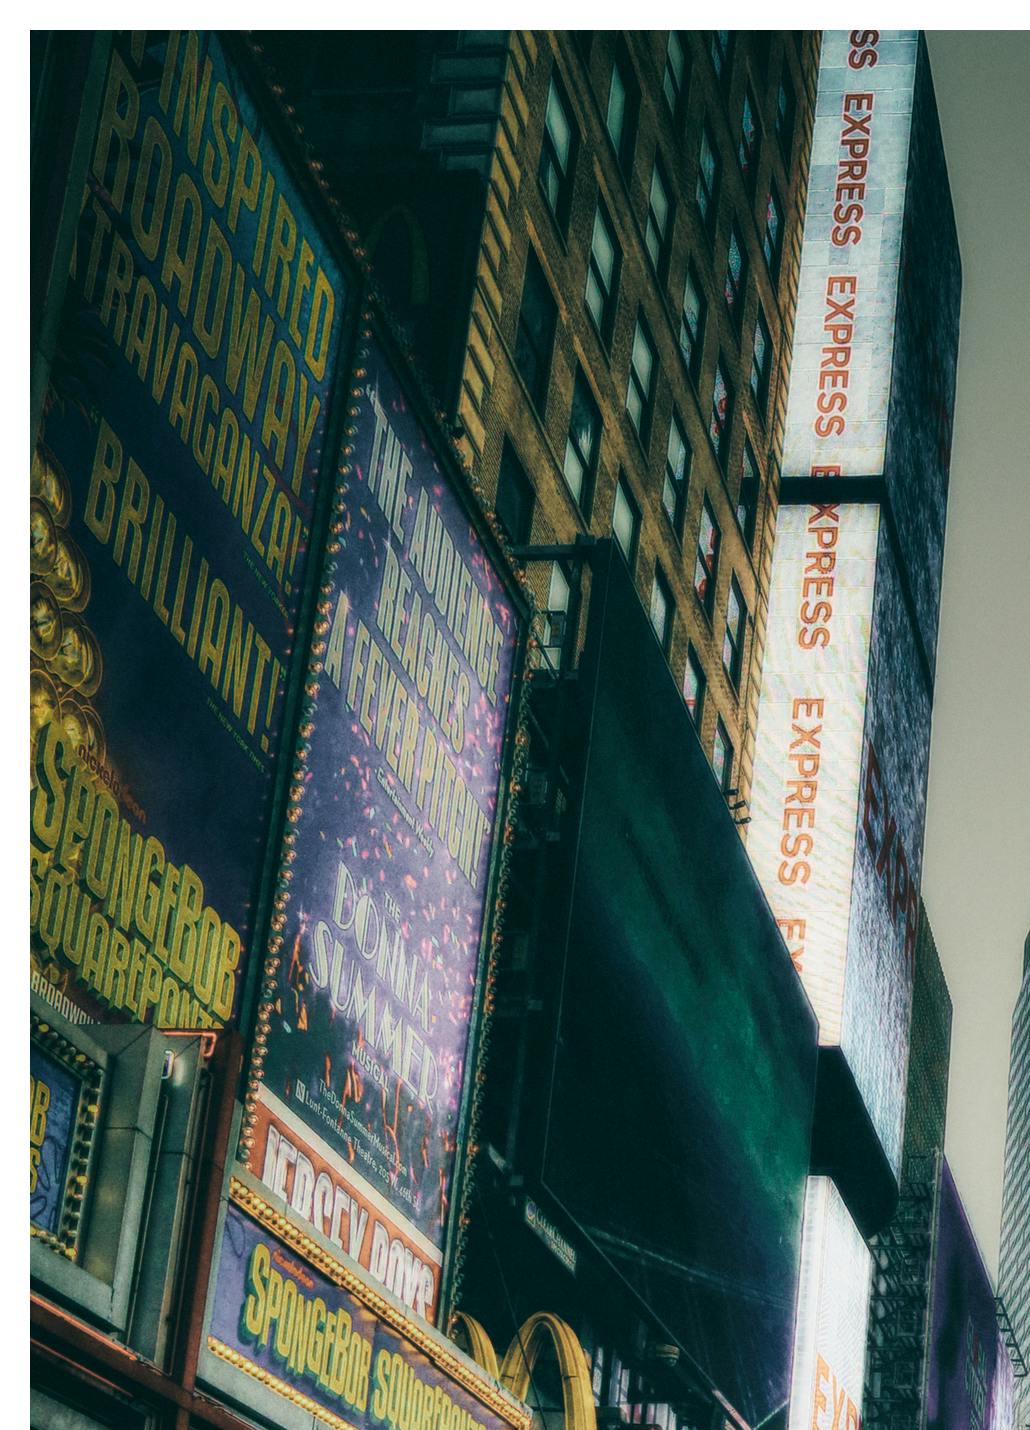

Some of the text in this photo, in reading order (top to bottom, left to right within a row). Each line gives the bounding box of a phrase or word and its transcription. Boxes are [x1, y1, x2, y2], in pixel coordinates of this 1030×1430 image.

[158, 30, 335, 382] INSPIRED
[831, 92, 873, 248] EXPRESS
[92, 48, 320, 498] ROADWAY
[814, 275, 857, 438] EXPRESS
[377, 544, 470, 753] REACHES
[410, 486, 504, 707] AUDIENCE
[325, 591, 347, 689] A
[347, 619, 420, 794] FEVER
[33, 722, 241, 1022] SPONGEBOB
[778, 697, 824, 887] EXPRESS
[333, 860, 433, 1035] DONNA
[384, 891, 400, 921] THE
[309, 921, 437, 1114] SUMMER
[352, 1041, 389, 1093] MUSICAL
[246, 1243, 373, 1413] SPONGEBOB
